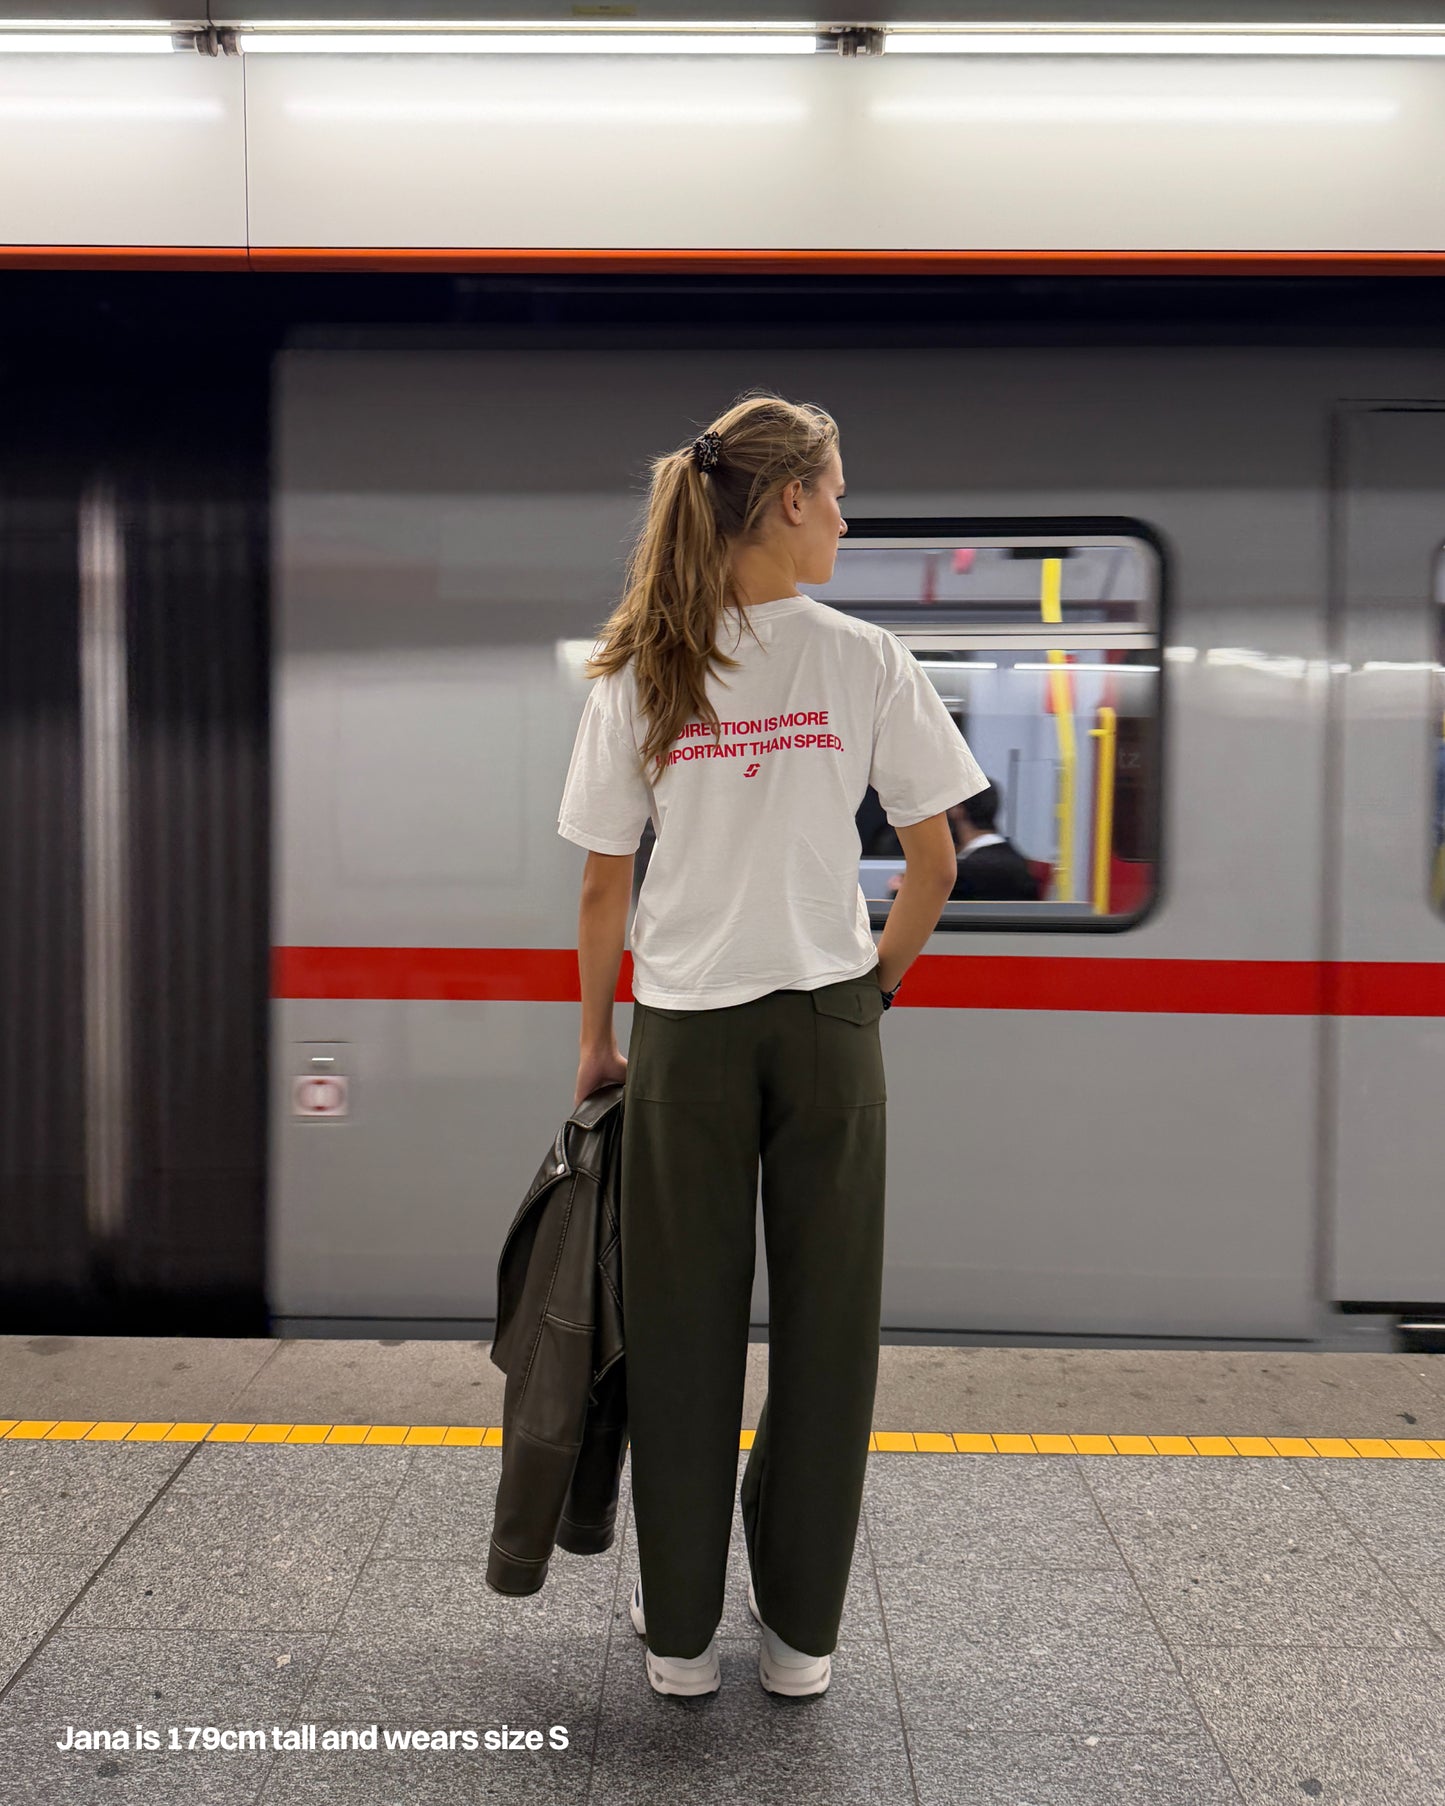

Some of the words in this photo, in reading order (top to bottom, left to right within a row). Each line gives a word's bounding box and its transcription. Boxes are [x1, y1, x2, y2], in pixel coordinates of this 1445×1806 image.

[764, 717, 778, 732] IS
[779, 711, 828, 728] MORE
[751, 736, 792, 757] THAN
[794, 734, 844, 752] SPEED.
